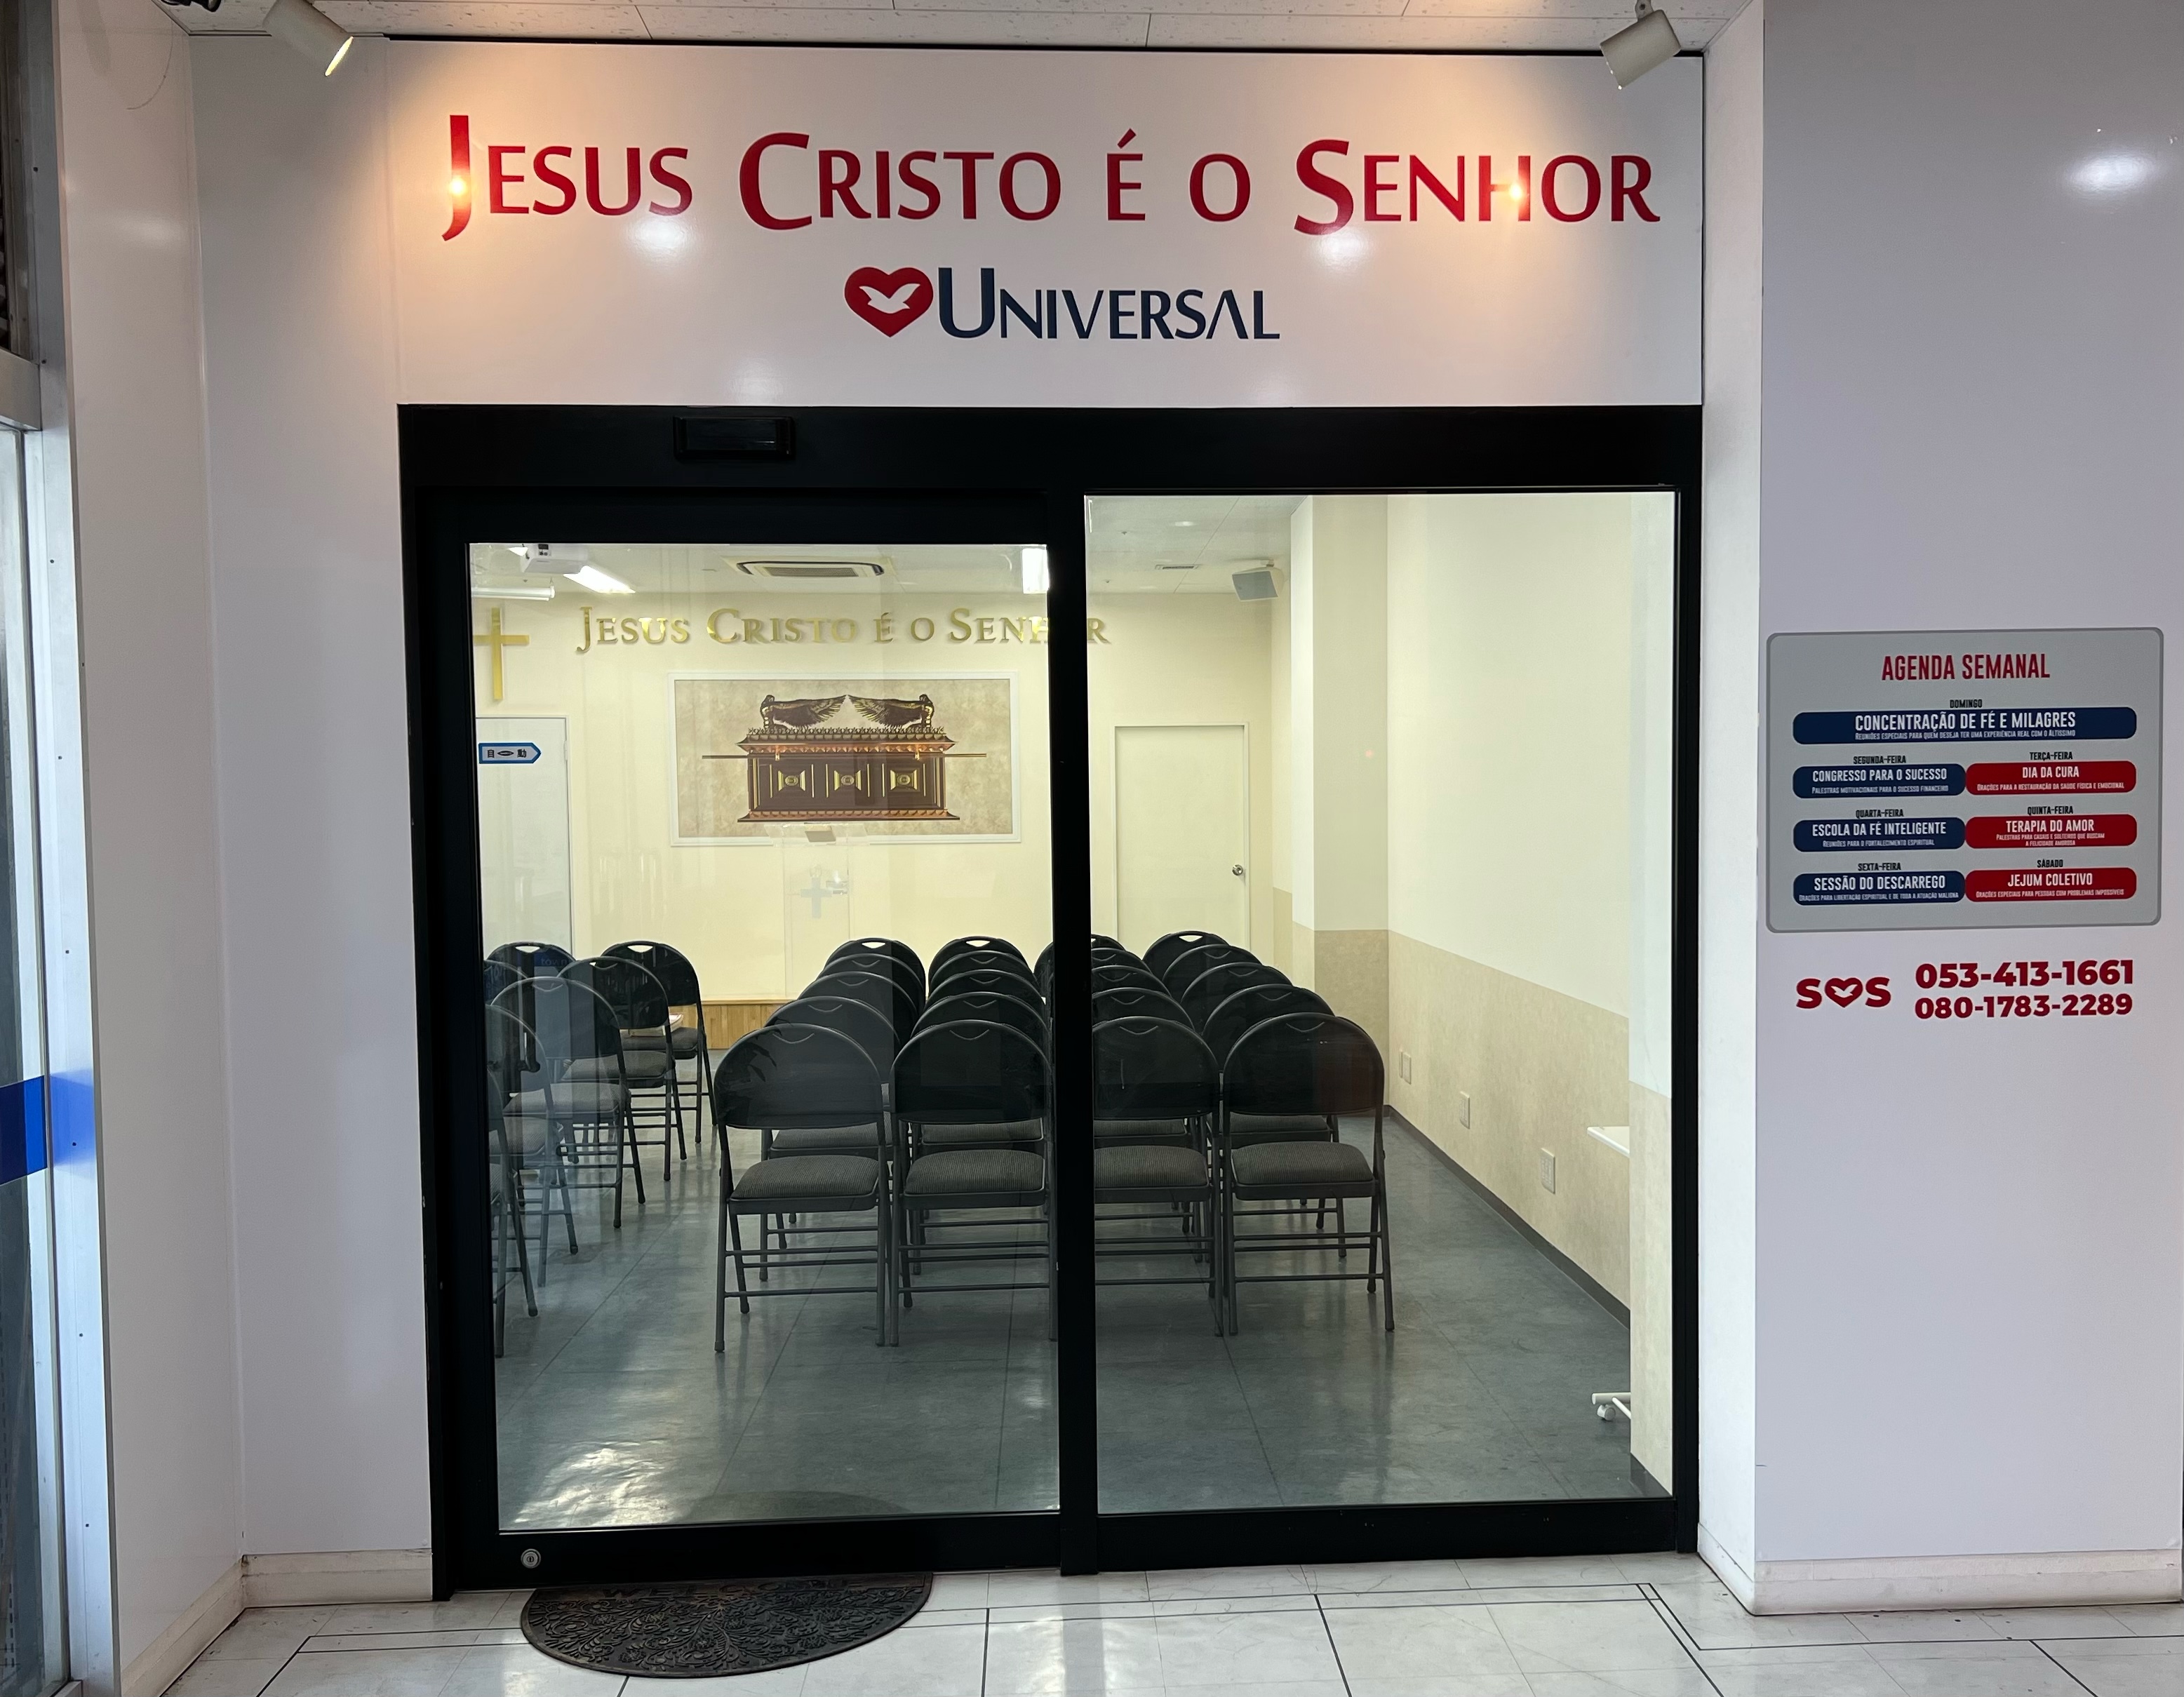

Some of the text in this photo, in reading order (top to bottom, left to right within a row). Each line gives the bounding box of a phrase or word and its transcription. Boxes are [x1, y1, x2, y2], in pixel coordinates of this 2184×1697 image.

[441, 114, 1661, 241] JESUS CRISTO É O SENHOR
[938, 267, 1280, 340] UNIVERSAL
[575, 605, 1111, 653] JESUS CRISTO É O SENHR
[1882, 653, 2050, 680] AGENDA SEMANAL
[1950, 699, 1983, 709] DOMINGO
[1855, 711, 2076, 732] CONCENTRAÇÃO DE FÉ E MILAGRES
[1853, 755, 1906, 765] SEGUNDA-FEIRA
[2030, 751, 2073, 761] TERÇA-FEIRA
[1812, 768, 1948, 782] CONGRESSO PARA O SUCESSO
[2022, 766, 2079, 778] DIA DA CURA
[1856, 809, 1903, 819] QUARTA-FEIRA
[2027, 805, 2073, 815] QUINTA-FEIRA
[1812, 821, 1946, 836] ESCOLA DA FÉ INTELIGENTE
[2006, 819, 2095, 833] TERAPIA DO AMOR
[1858, 863, 1901, 871] SEXTA-FEIRA
[2037, 859, 2063, 868] SÁBADO
[1814, 876, 1945, 890] SESSÃO DO DESCARREGO
[2008, 873, 2093, 887] JEJUM COLETIVO
[1915, 960, 2133, 989] 053-413-1661
[1915, 993, 2133, 1019] 080-1783-2289
